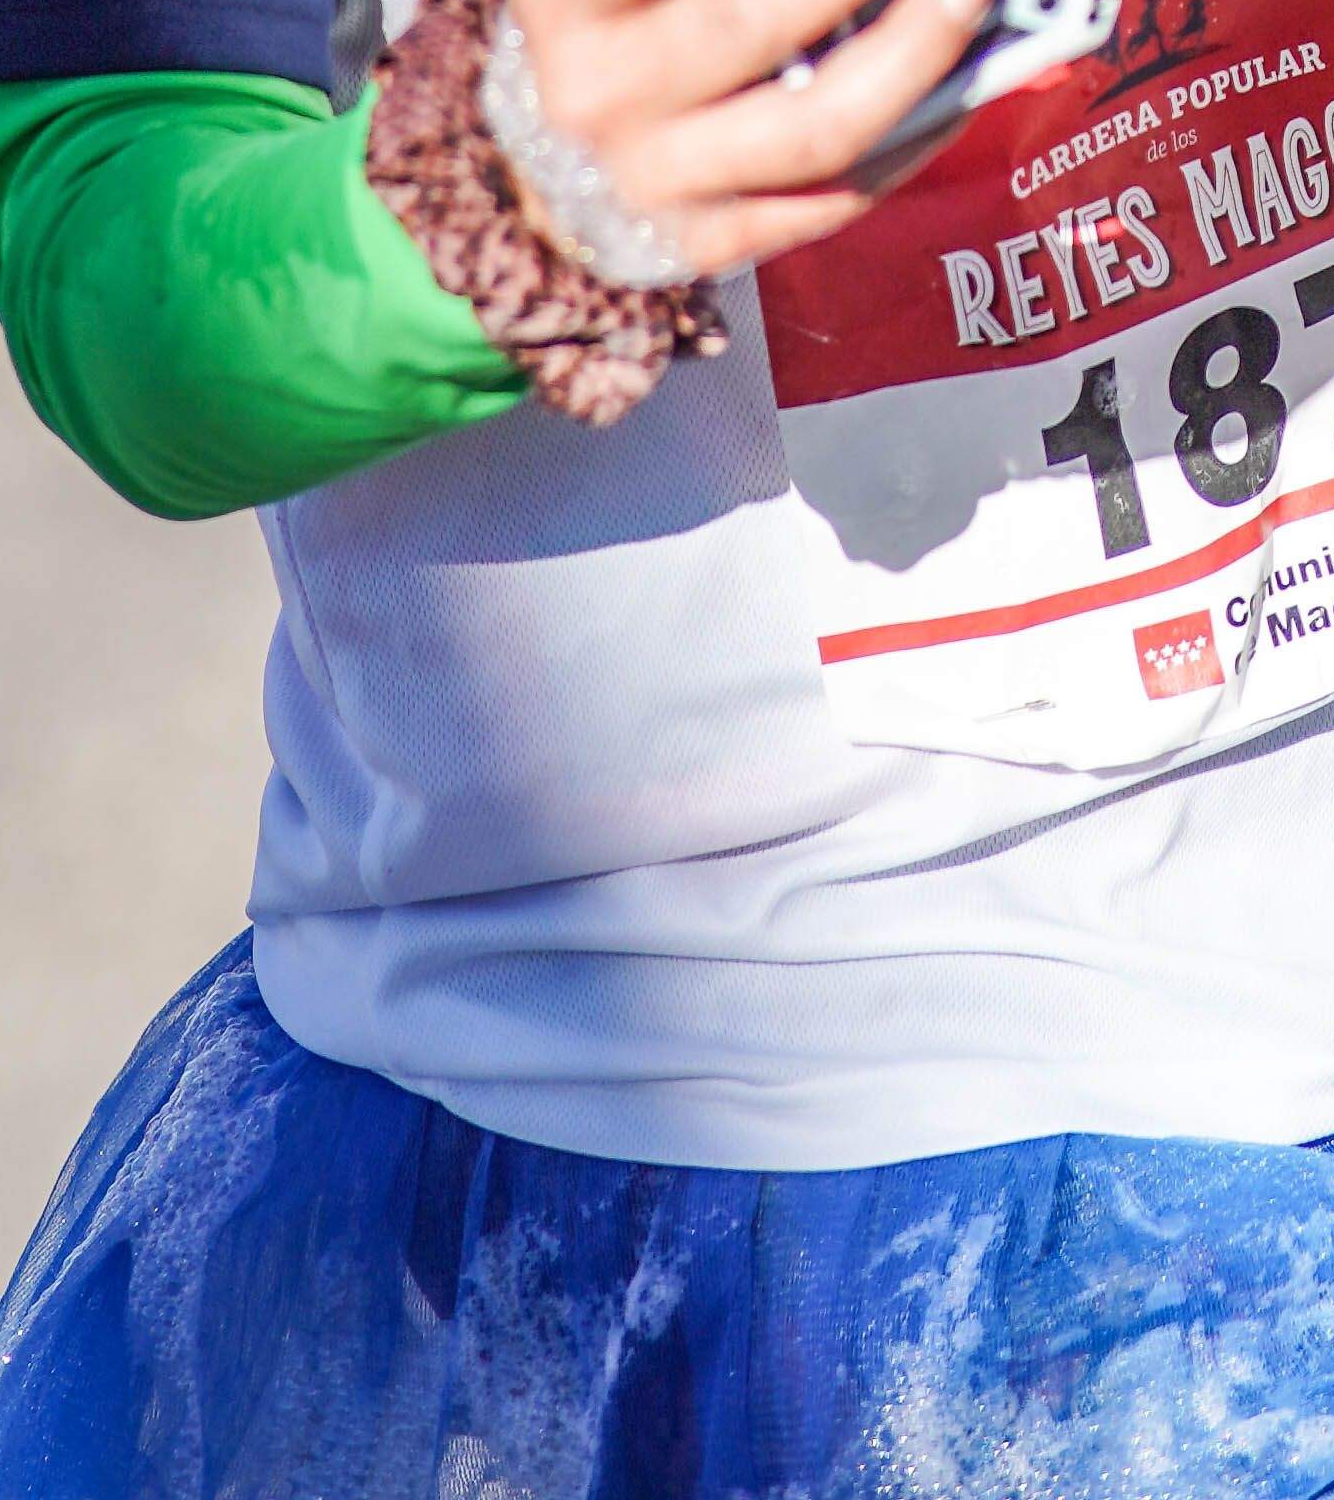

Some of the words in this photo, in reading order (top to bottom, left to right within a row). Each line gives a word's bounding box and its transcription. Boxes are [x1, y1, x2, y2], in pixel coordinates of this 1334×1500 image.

[1010, 100, 1162, 199] CARRERA
[1166, 41, 1325, 121] POPULAR
[1146, 140, 1168, 164] de
[1168, 125, 1198, 154] los
[939, 185, 1170, 348] REYES
